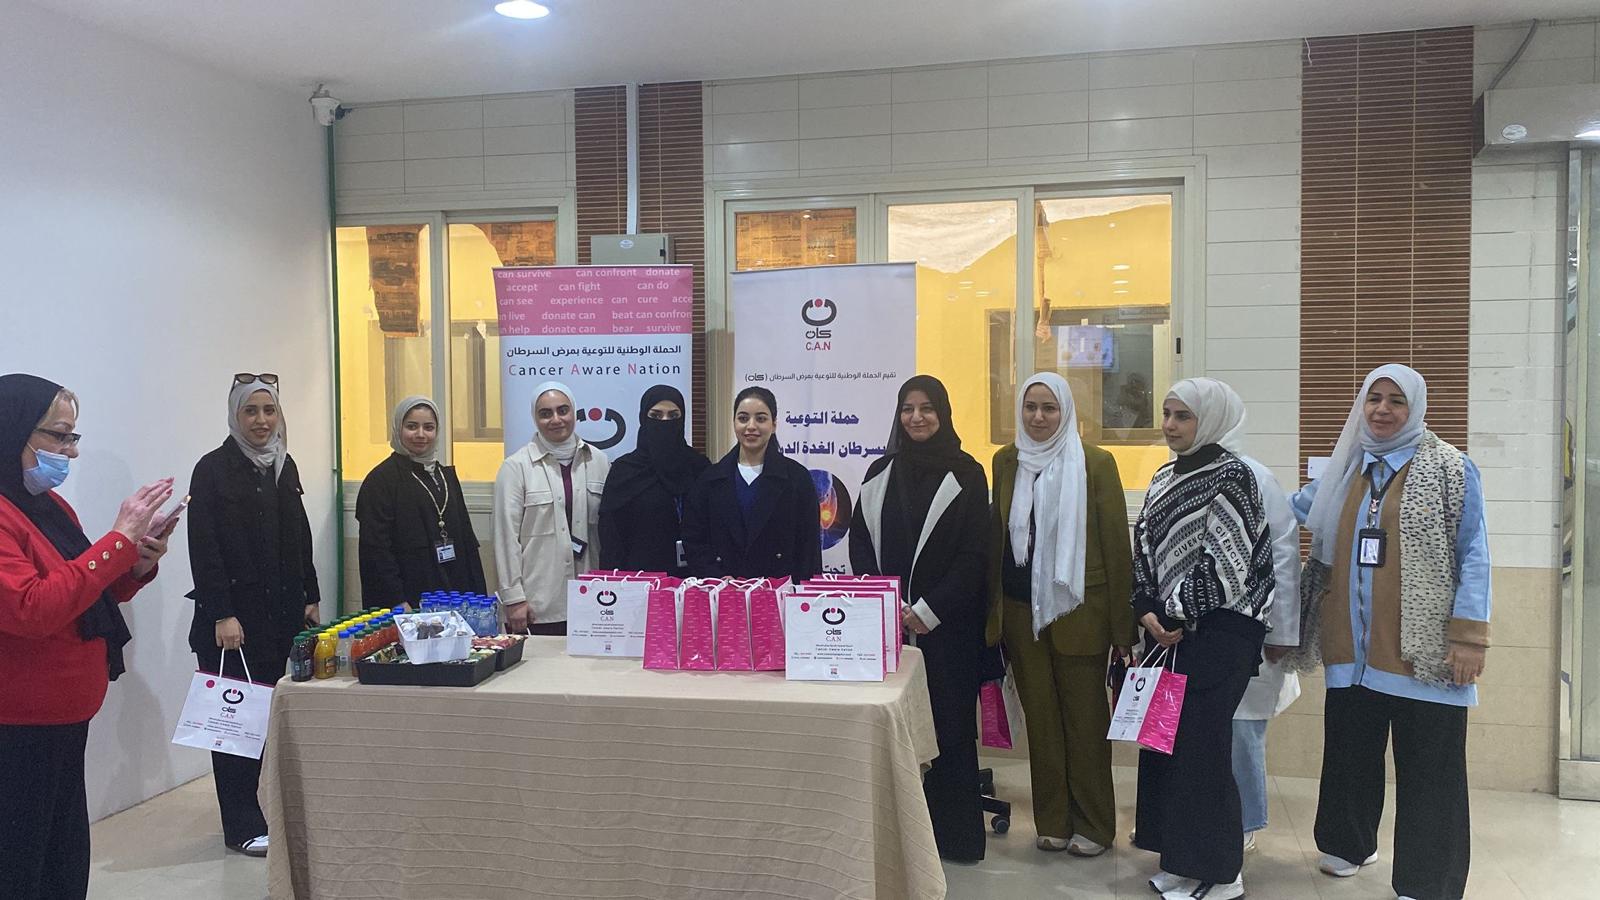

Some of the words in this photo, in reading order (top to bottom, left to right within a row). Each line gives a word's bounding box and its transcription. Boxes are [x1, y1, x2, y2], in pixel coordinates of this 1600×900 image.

[497, 270, 514, 278] can
[517, 269, 552, 278] survive
[576, 270, 594, 278] can
[596, 268, 637, 277] confront
[646, 268, 680, 276] donate
[506, 283, 538, 293] accept
[578, 282, 600, 293] fight
[657, 281, 669, 290] do
[500, 298, 514, 306] can
[550, 296, 604, 306] experience
[611, 296, 628, 304] can
[637, 296, 658, 304] cure
[508, 311, 526, 321] live
[541, 311, 576, 320] donate
[579, 312, 596, 320] can
[612, 310, 633, 319] beat
[508, 324, 530, 335] help
[541, 324, 576, 334] donate
[612, 324, 634, 333] bear
[646, 323, 681, 332] survive
[581, 346, 615, 356] للتوعية
[616, 345, 651, 356] الوطنية
[652, 345, 682, 354] الحملة
[805, 341, 832, 351] C.A.N
[506, 347, 550, 358] السرطان
[551, 347, 580, 357] بمرض
[508, 364, 564, 376] Cancer
[570, 363, 621, 376] Aware
[627, 362, 681, 376] Nation
[769, 373, 795, 382] السرطان
[838, 372, 862, 381] الوطنية
[862, 372, 882, 380] الحملة
[785, 411, 828, 427] التوعية
[830, 411, 860, 425] حملة
[801, 440, 835, 455] الغدة
